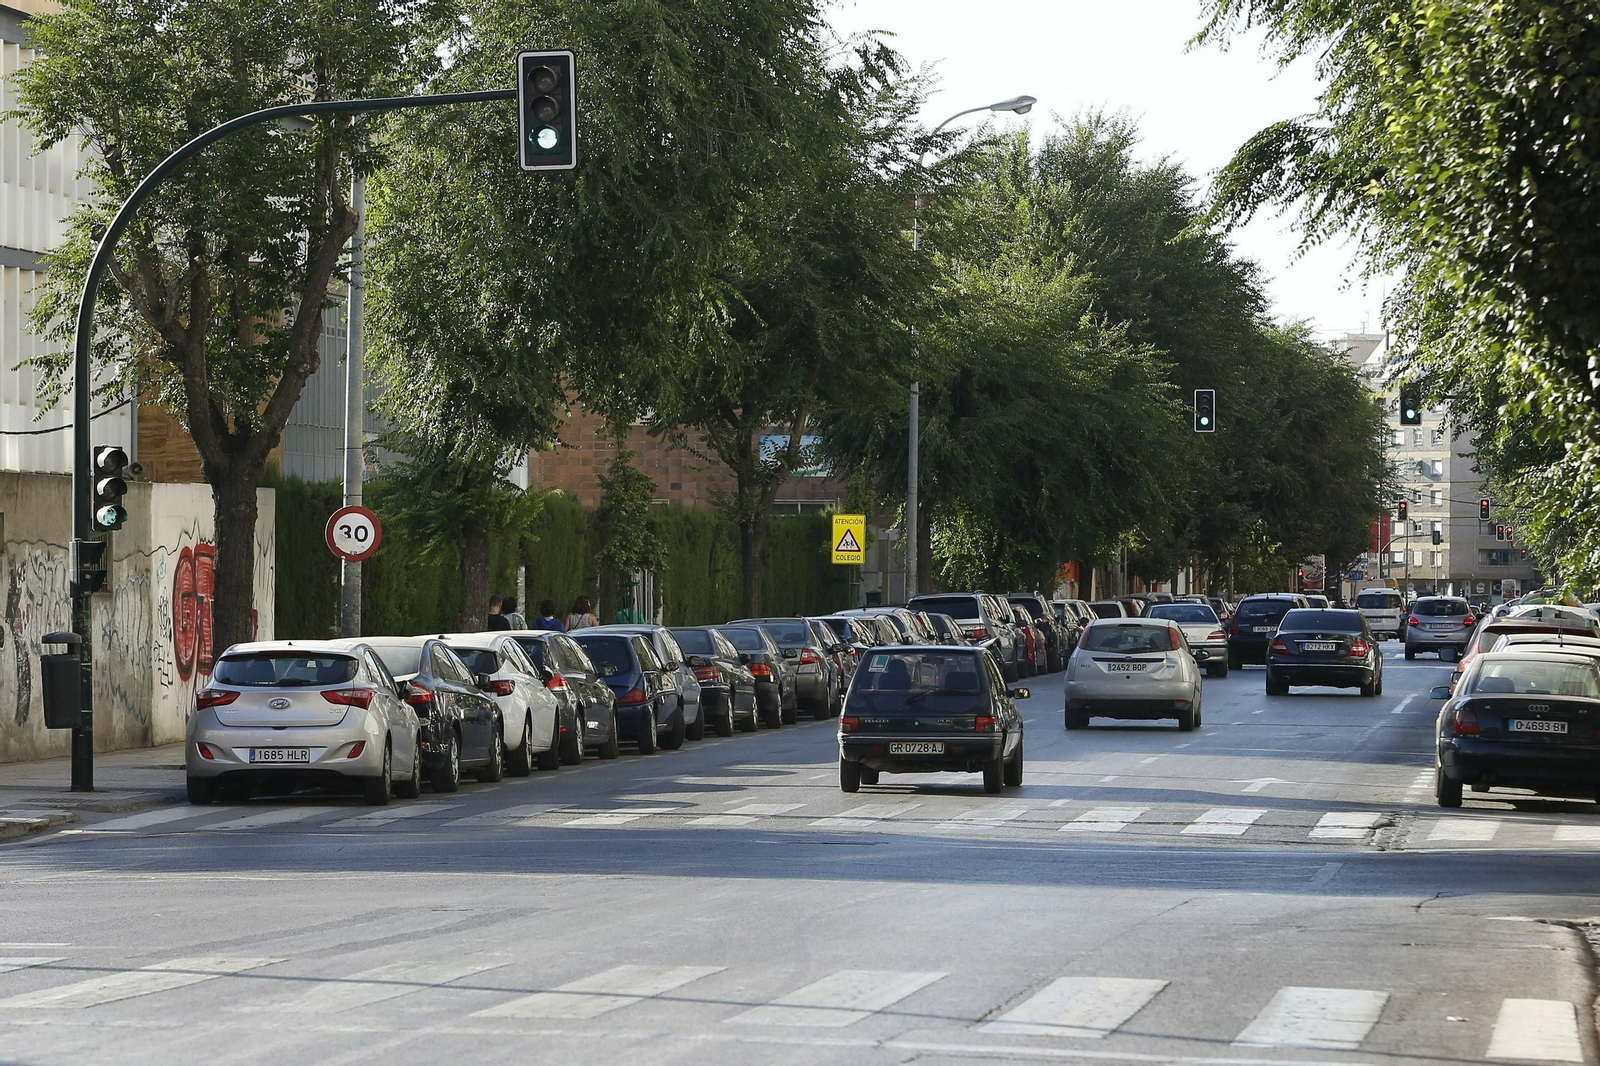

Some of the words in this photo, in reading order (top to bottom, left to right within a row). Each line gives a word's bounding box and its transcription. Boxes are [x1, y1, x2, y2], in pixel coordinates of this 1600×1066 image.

[339, 524, 369, 543] 30
[1112, 663, 1131, 672] 2452
[257, 750, 284, 760] 1685
[287, 750, 307, 760] HLR
